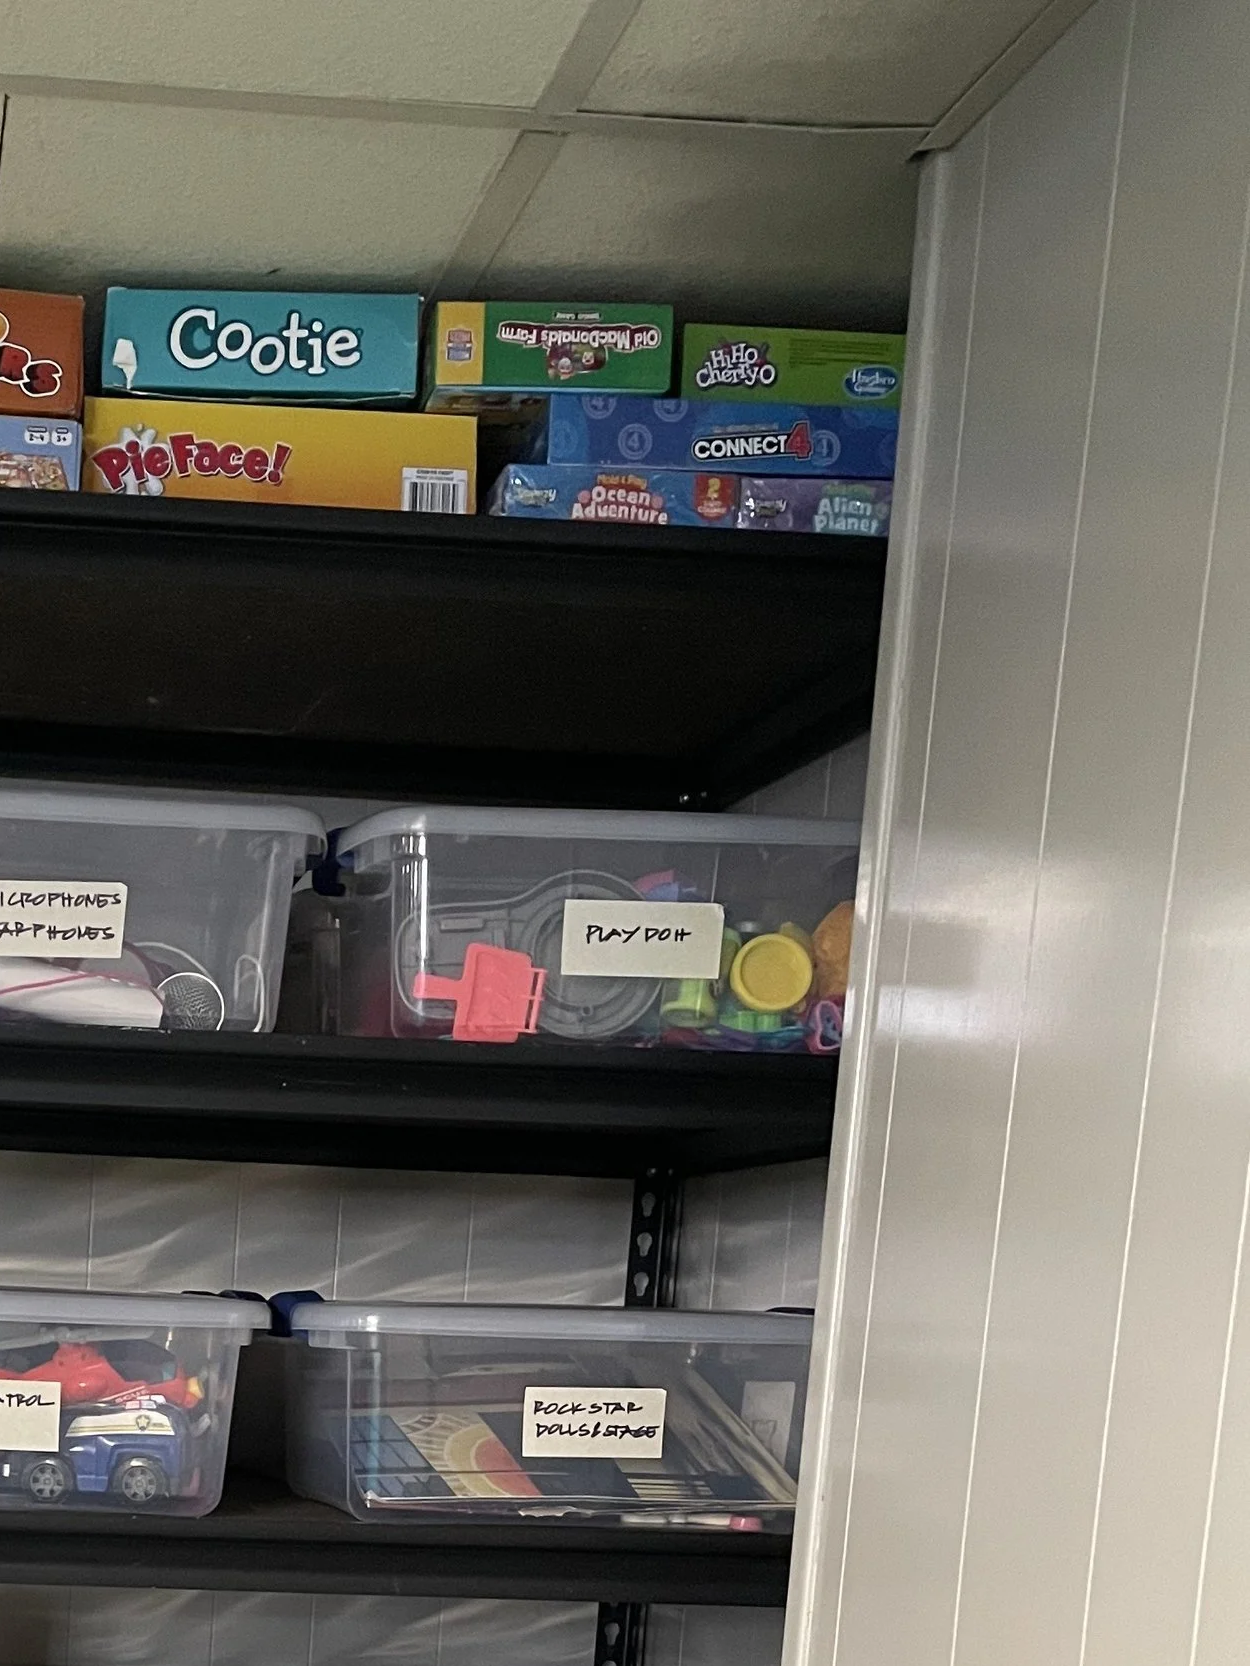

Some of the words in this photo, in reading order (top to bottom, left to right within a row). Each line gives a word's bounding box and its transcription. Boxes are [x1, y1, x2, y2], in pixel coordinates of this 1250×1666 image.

[170, 307, 362, 376] Cootie
[501, 327, 537, 344] Farm
[635, 329, 658, 347] Old
[694, 435, 788, 459] CONNECT
[592, 486, 650, 506] Ocean
[817, 496, 872, 516] Alien
[571, 502, 668, 525] Adventure
[813, 514, 879, 535] Planet
[586, 924, 641, 944] PLAY
[644, 927, 692, 943] DOH
[533, 1400, 586, 1415] ROCK
[588, 1402, 643, 1415] STAR
